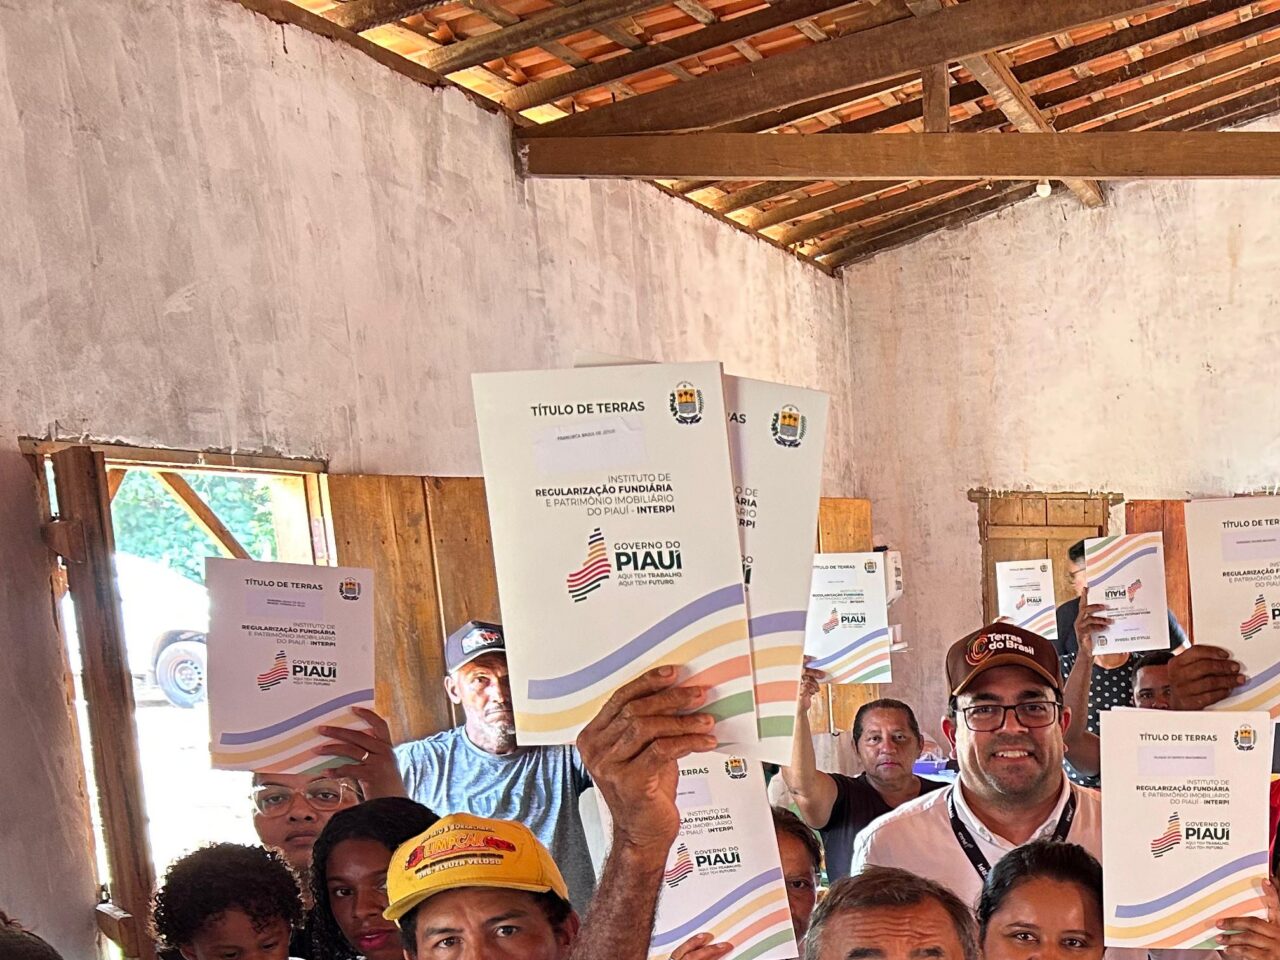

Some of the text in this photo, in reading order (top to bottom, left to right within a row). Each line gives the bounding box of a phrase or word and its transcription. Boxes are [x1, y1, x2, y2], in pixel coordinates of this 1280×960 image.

[531, 402, 645, 416] TÍTULO DE TERRAS
[608, 473, 672, 484] INSTITUTO DE
[535, 482, 673, 497] REGULARIZAÇÃO FUNDIÁRIA
[546, 493, 674, 507] E PATRIMÔNIO IMOBILIÁRIO
[587, 508, 602, 516] DO
[604, 504, 629, 516] PIAUÍ
[636, 505, 675, 514] INTERPI
[1222, 520, 1250, 528] TÍTULO
[614, 541, 681, 551] GOVERNO DO
[615, 549, 682, 572] PIAUÍ
[1222, 568, 1274, 577] REGULARIZAÇÃO
[245, 578, 275, 587] TÍTULO
[291, 582, 323, 590] TERRAS
[242, 625, 298, 633] REGULARIZAÇÃO
[988, 633, 1022, 643] Terras
[988, 640, 1034, 655] do Brasil
[292, 665, 337, 678] PIAUÍ
[1140, 732, 1169, 741] TÍTULO
[1136, 785, 1191, 793] REGULARIZAÇÃO
[687, 809, 719, 817] INSTITUTO
[695, 814, 731, 822] FUNDIÁRIA
[686, 828, 703, 836] PIAUÍ
[1185, 828, 1230, 840] PIAUÍ
[694, 847, 727, 856] GOVERNO
[695, 851, 741, 868] PIAUÍ
